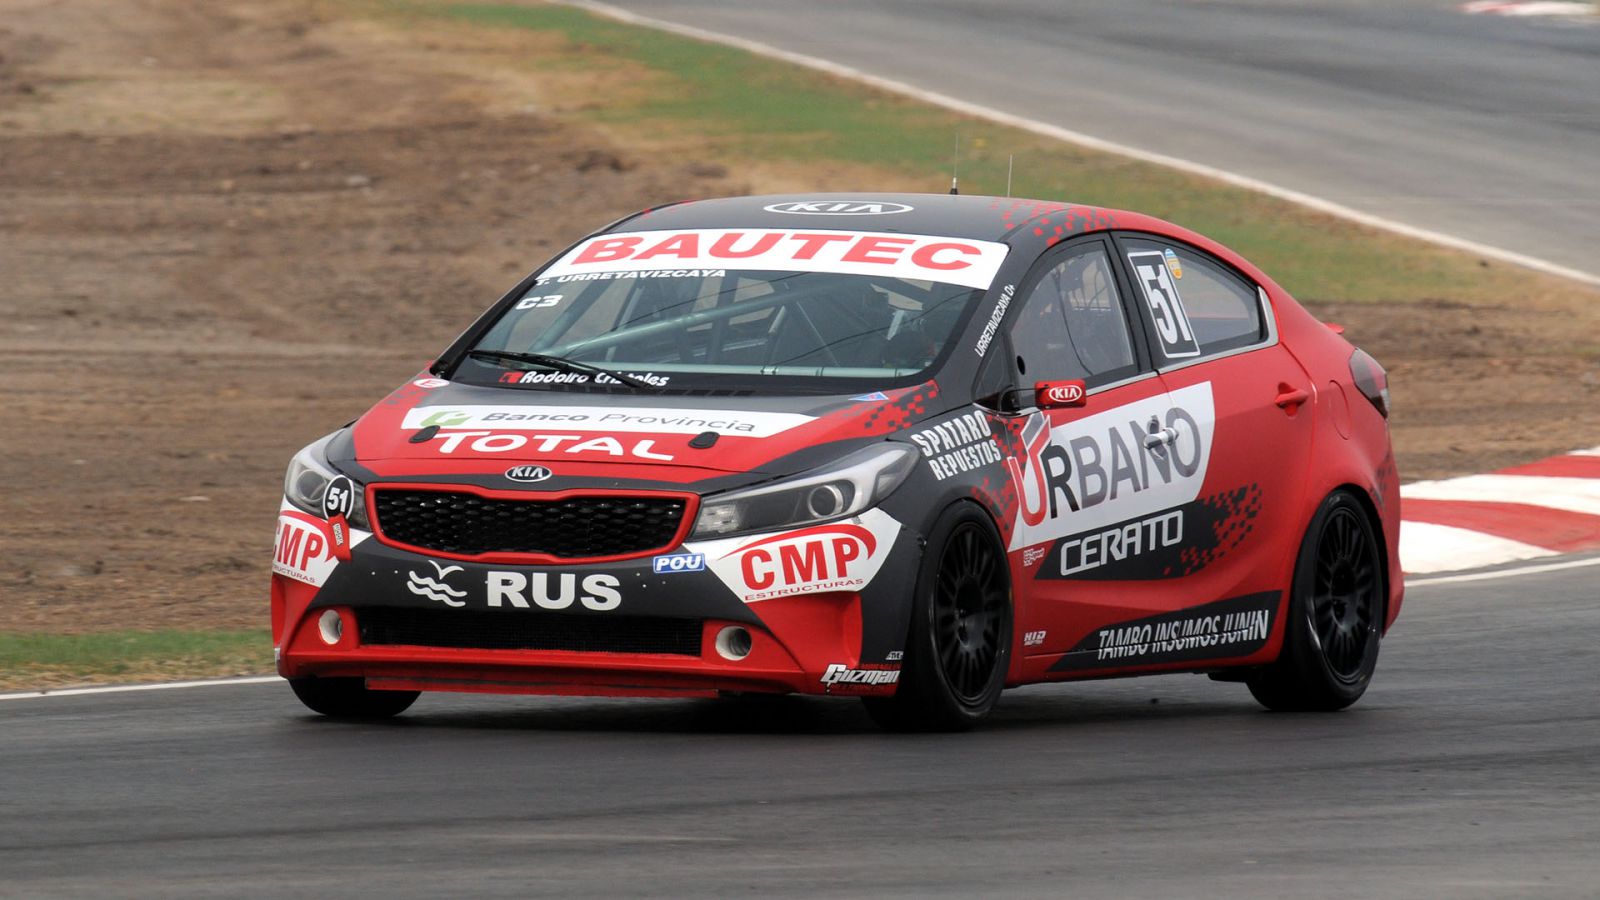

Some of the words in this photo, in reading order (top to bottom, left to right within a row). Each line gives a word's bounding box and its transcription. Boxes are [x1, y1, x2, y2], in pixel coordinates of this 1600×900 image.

[787, 202, 883, 213] KIA
[572, 232, 982, 271] BAUTEC
[557, 269, 726, 283] URRETAVIZCAYA
[515, 294, 563, 310] C3
[1136, 264, 1193, 344] 51
[974, 293, 1012, 357] URRETAVIZCAYA
[1055, 387, 1077, 399] KIA
[481, 412, 590, 421] Banco
[599, 413, 755, 432] Provincia
[911, 410, 992, 457] SPATARO
[434, 431, 674, 461] TOTAL
[929, 439, 1001, 481] REPUESTOS
[511, 467, 544, 478] KIA
[1007, 407, 1201, 527] URBANO
[327, 487, 348, 513] 51
[1060, 510, 1183, 576] CERATO
[656, 555, 702, 571] POU
[741, 537, 860, 591] CMP
[487, 571, 622, 611] RUS
[745, 578, 864, 601] ESTRUCTURAS
[1098, 624, 1152, 660] TAMBO
[1152, 614, 1220, 653] INSUMOS
